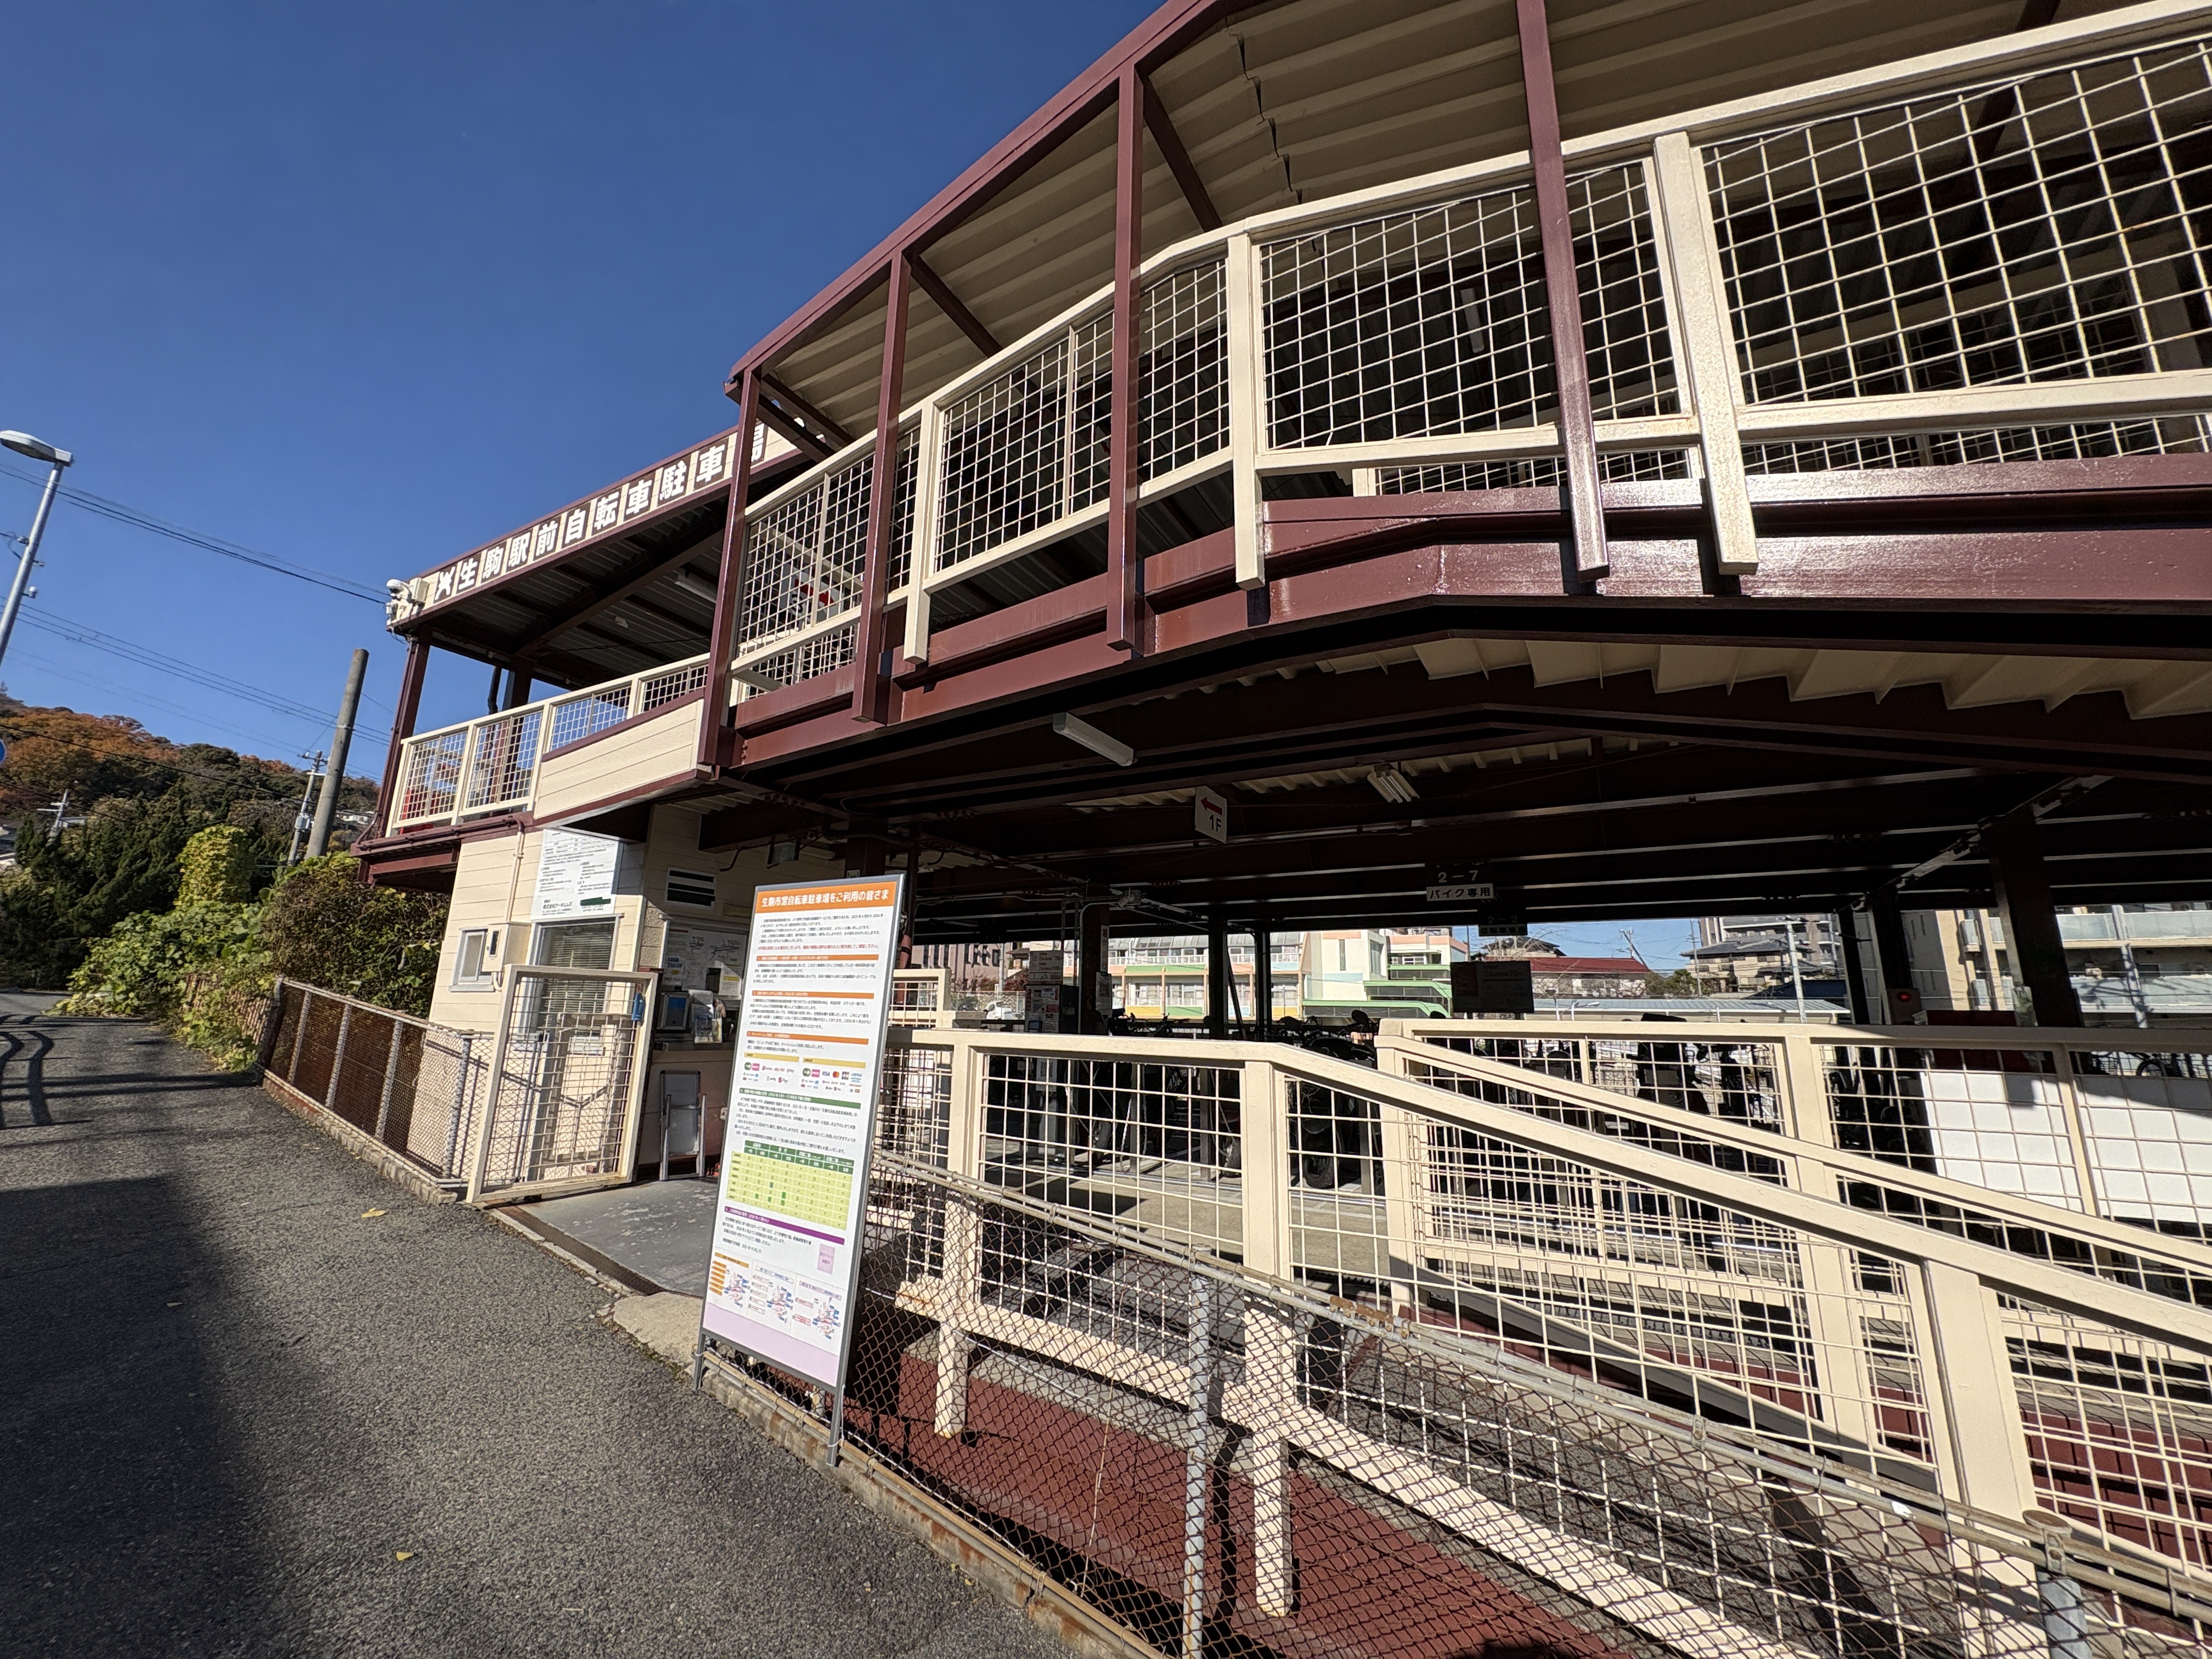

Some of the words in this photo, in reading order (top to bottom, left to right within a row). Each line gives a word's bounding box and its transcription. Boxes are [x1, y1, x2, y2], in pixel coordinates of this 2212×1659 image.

[1209, 814, 1221, 832] 1F
[761, 889, 889, 907] 生駒市営自転車駐車場をご利用の皆さま
[1430, 887, 1490, 899] バイク専用
